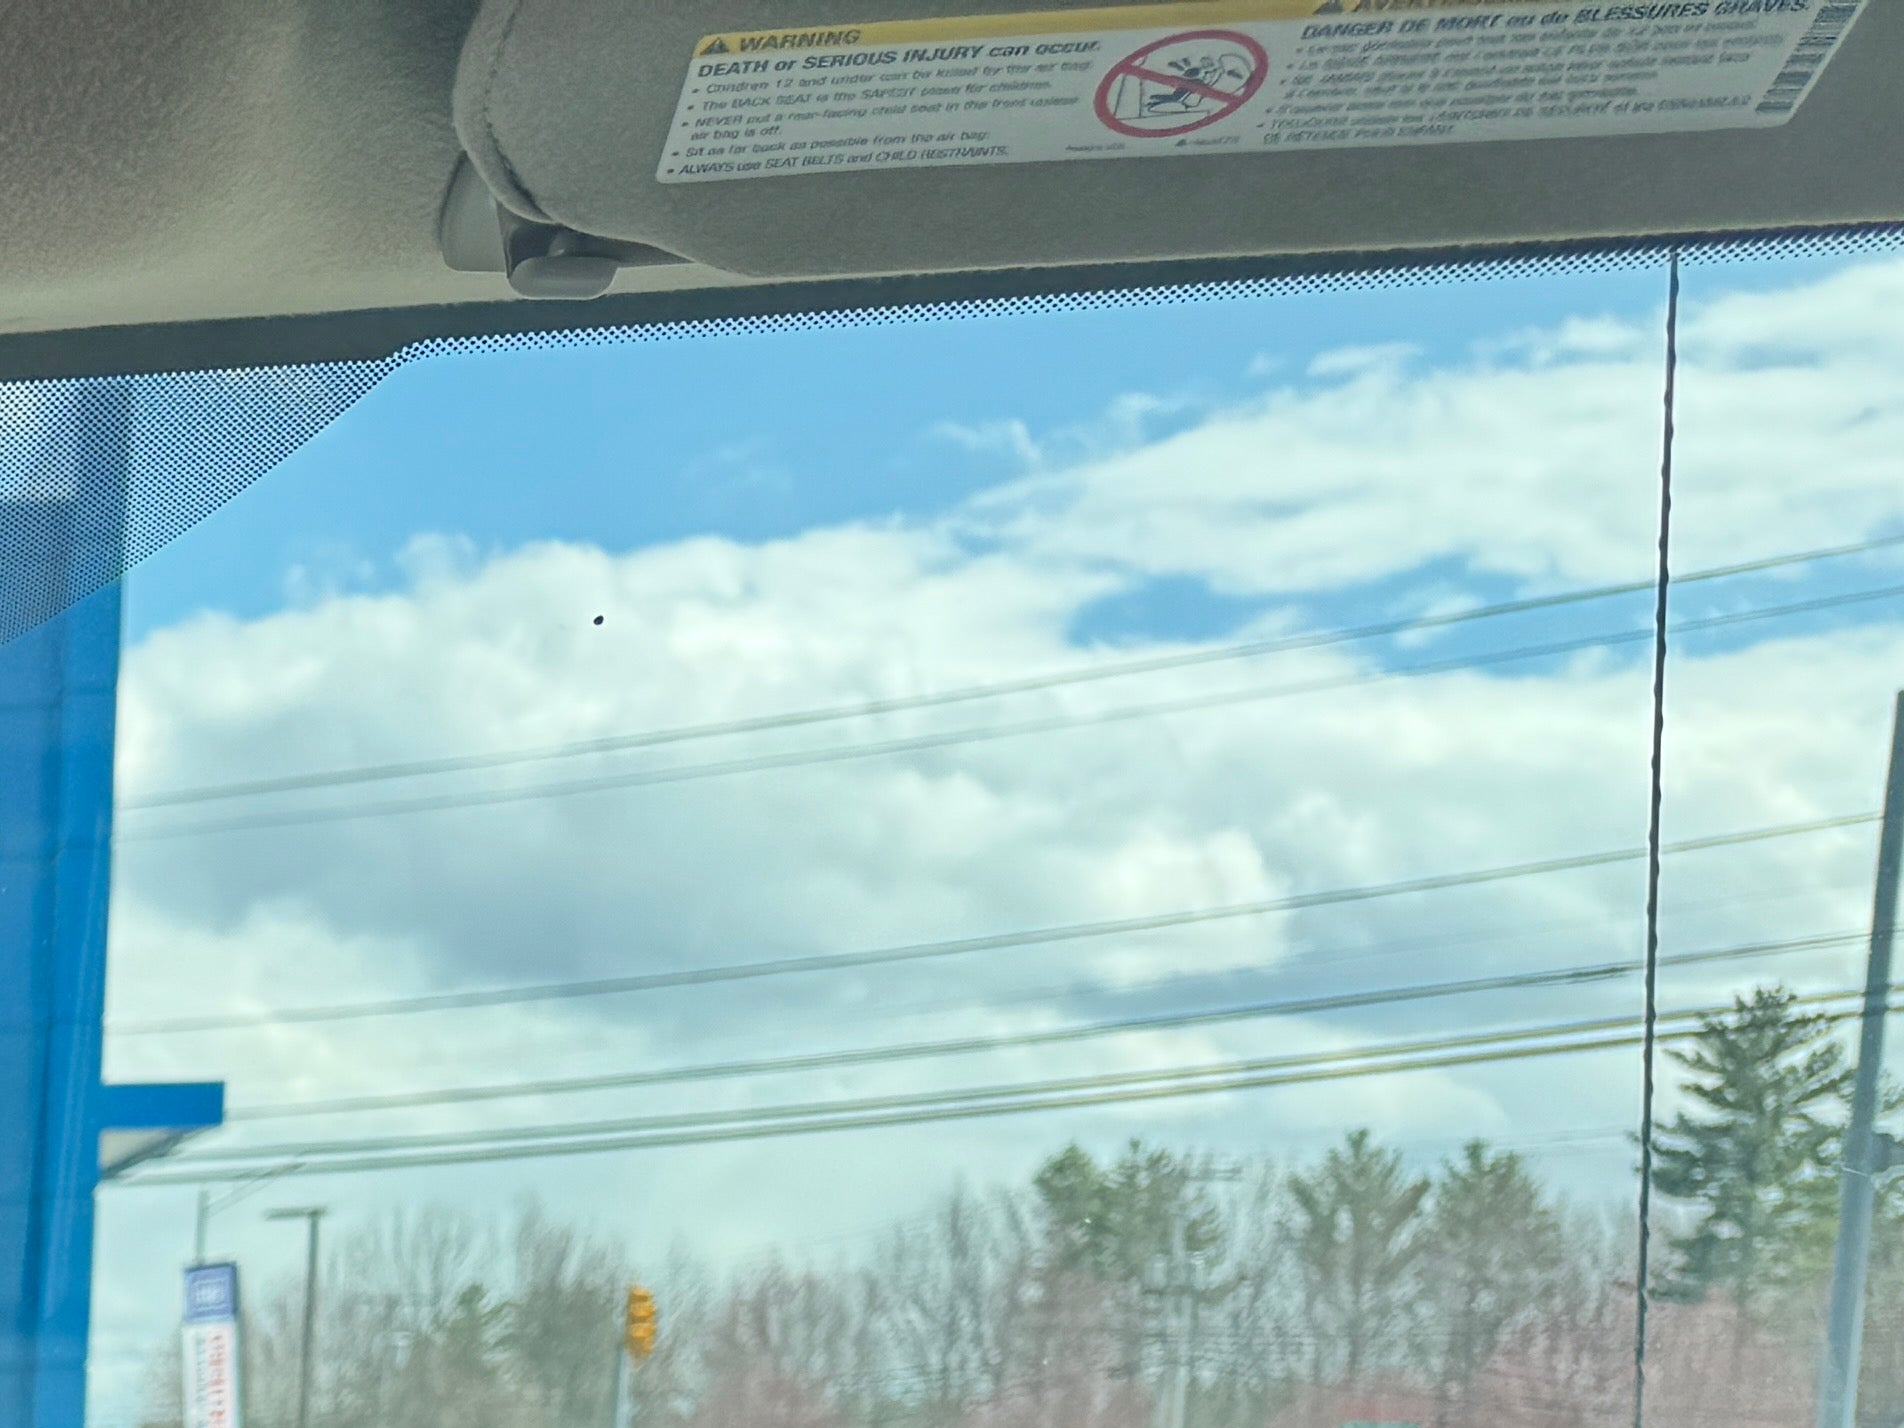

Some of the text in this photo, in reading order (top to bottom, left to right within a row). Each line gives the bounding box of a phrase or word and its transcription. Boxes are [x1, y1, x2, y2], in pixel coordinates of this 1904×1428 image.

[739, 30, 861, 52] WARNING
[698, 60, 769, 78] DEATH
[774, 60, 796, 72] or
[802, 51, 896, 70] SERIOUS
[903, 45, 984, 62] INJURY
[989, 44, 1030, 57] can
